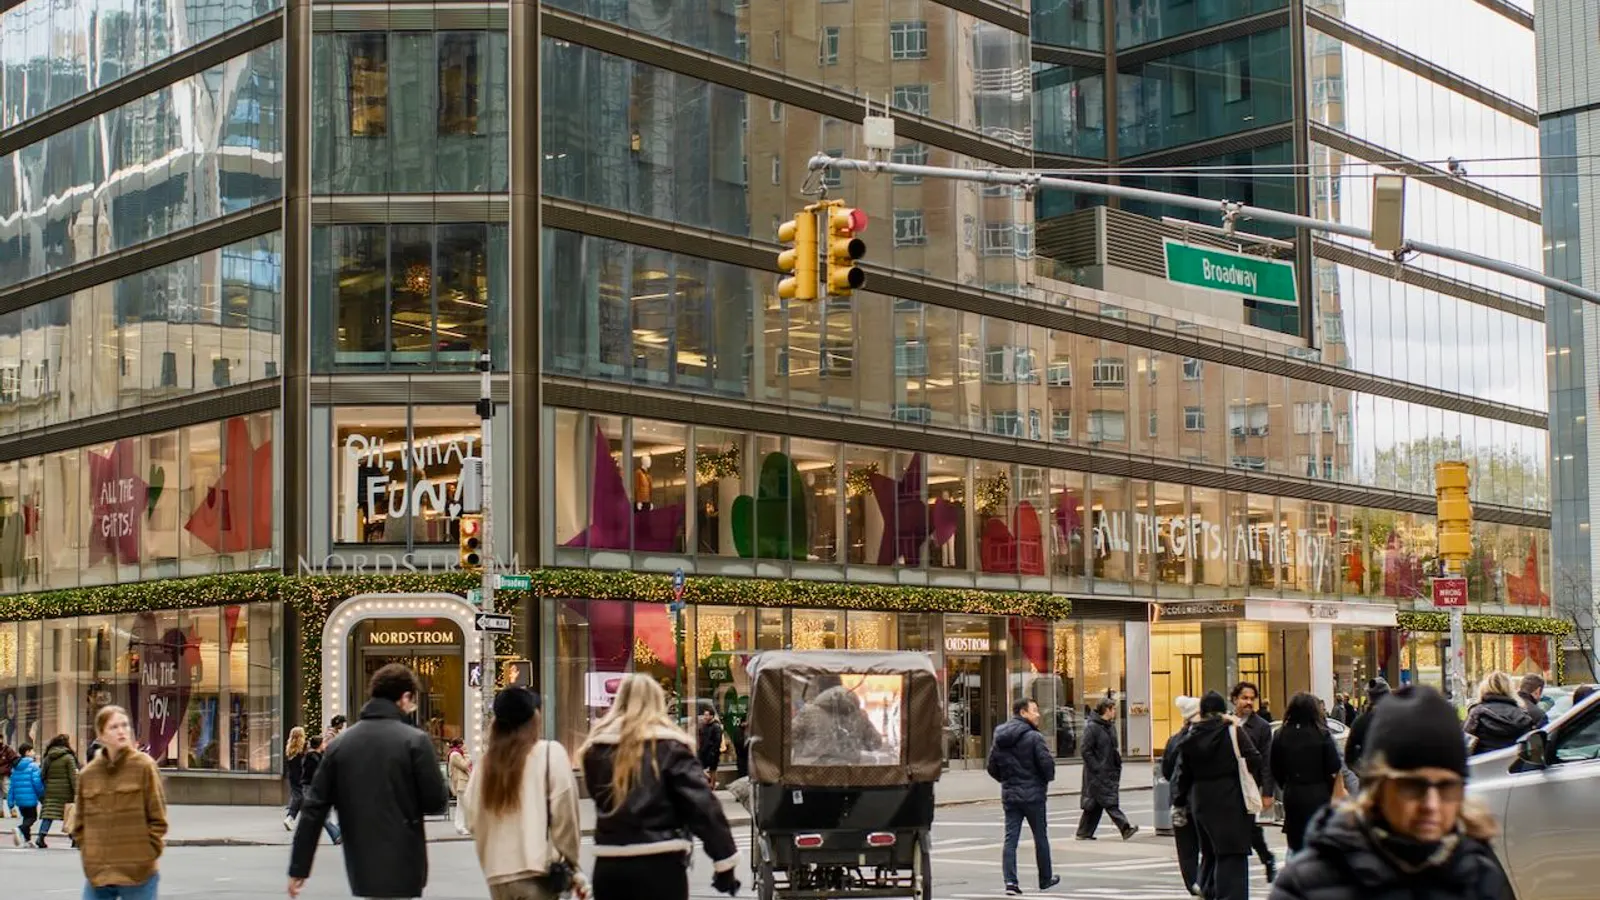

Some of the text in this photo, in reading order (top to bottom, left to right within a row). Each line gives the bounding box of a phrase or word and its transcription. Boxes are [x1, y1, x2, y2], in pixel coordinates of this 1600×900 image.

[1202, 257, 1258, 294] Broadway
[345, 433, 476, 472] OH, WHAT
[100, 478, 135, 505] ALL THE
[101, 506, 134, 537] GIFTS!
[1096, 509, 1130, 553] ALL
[1134, 512, 1165, 555] THE
[1170, 513, 1230, 562] GIFTS!
[1235, 523, 1263, 561] ALL
[1266, 526, 1290, 565] THE
[298, 552, 520, 577] NORDSTRM
[501, 576, 528, 589] Broadway
[1440, 589, 1462, 597] WRONG
[1444, 597, 1458, 605] WAY
[370, 632, 453, 643] NORDSTROM
[142, 661, 176, 686] ALL THE
[147, 693, 170, 735] JOY.
